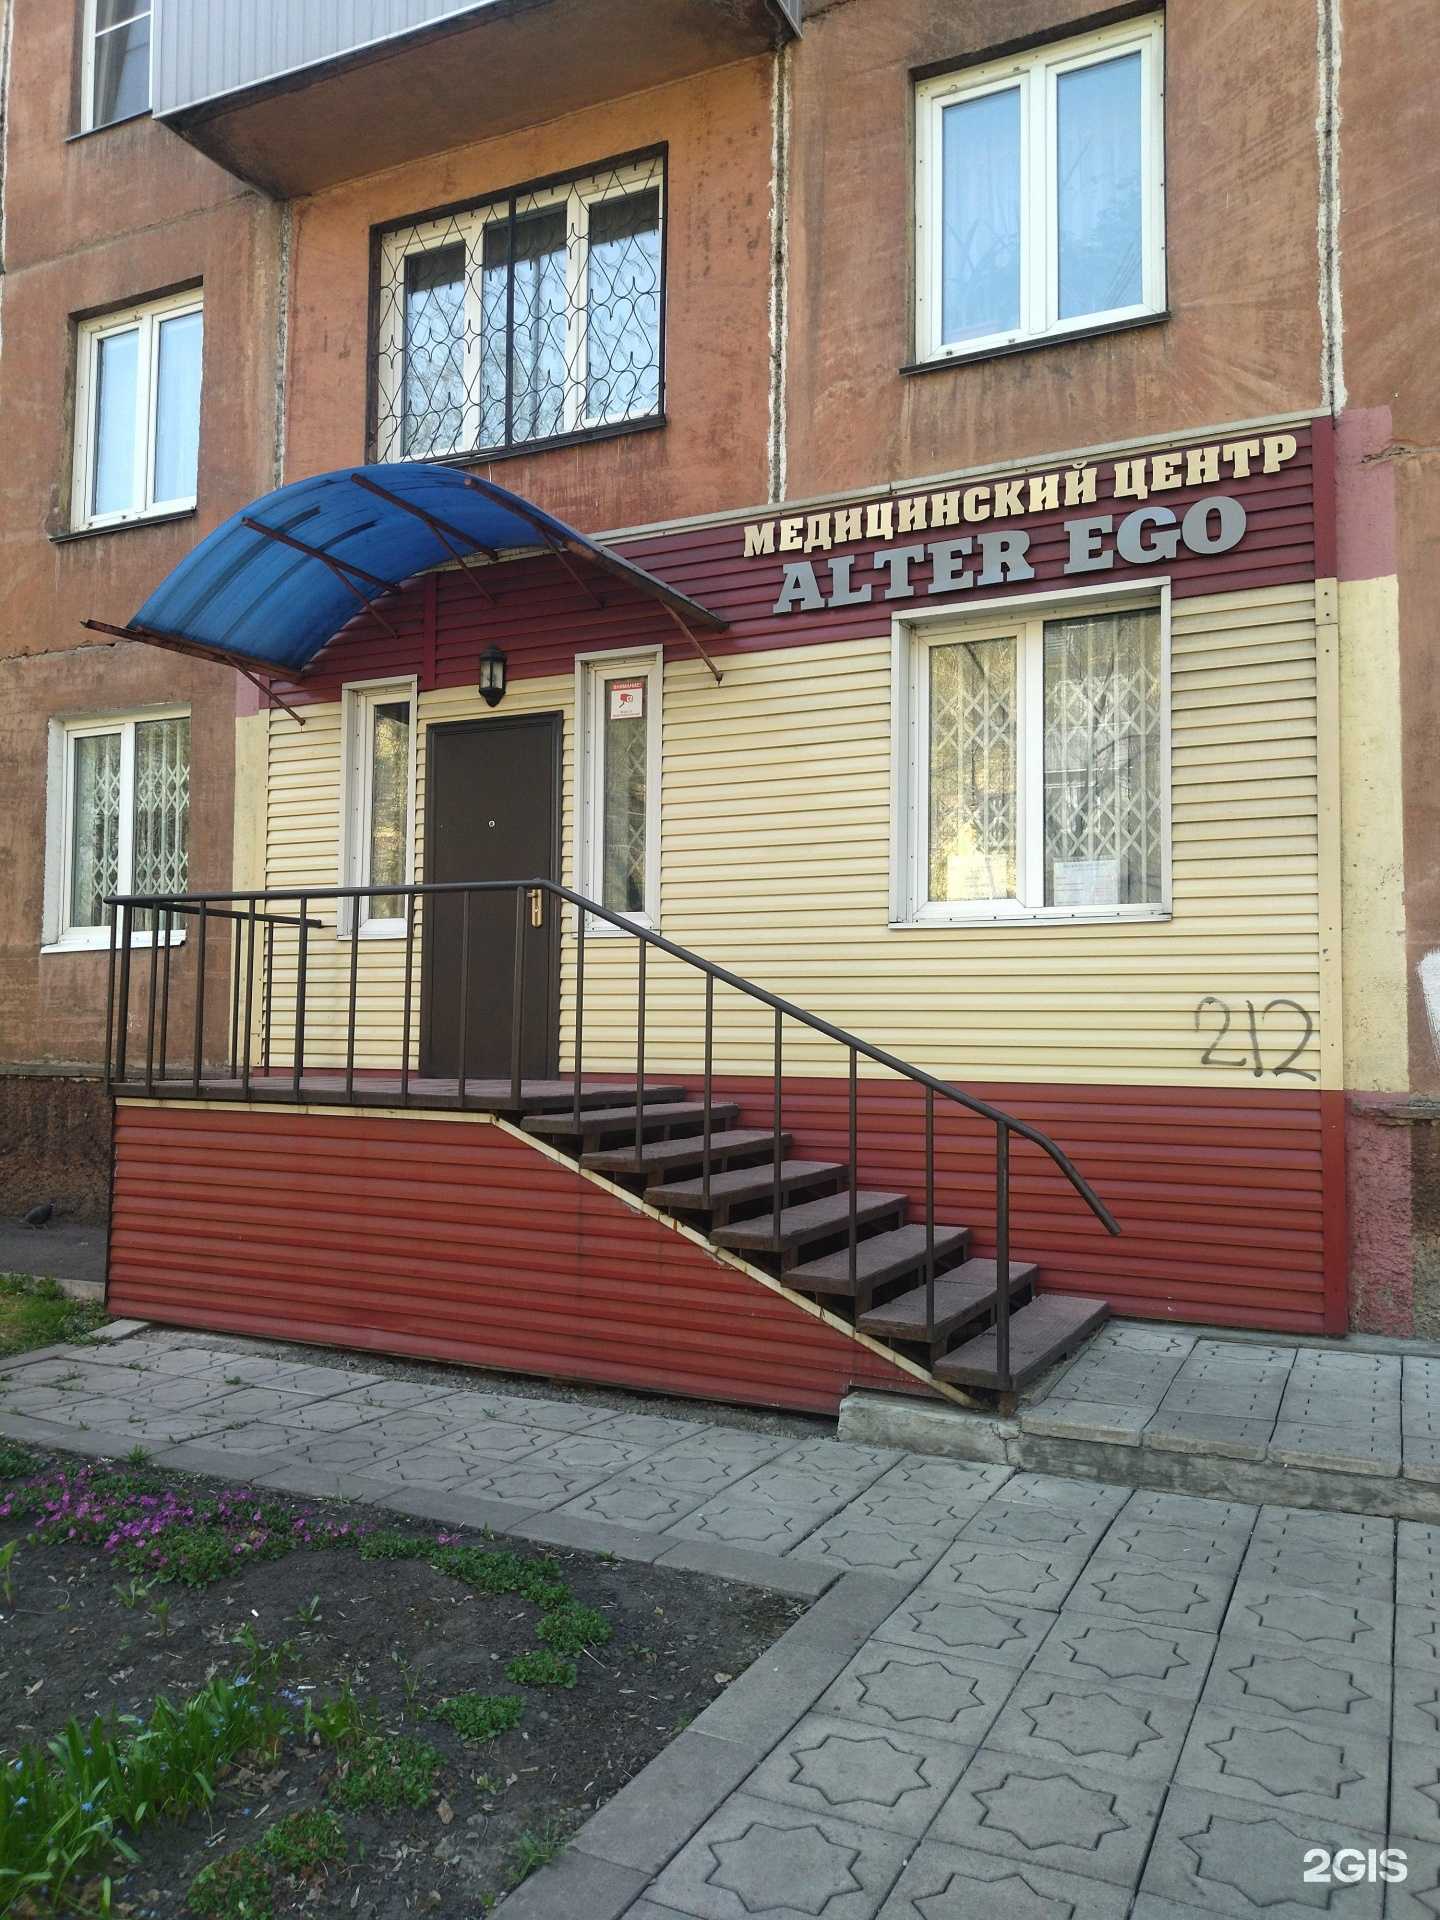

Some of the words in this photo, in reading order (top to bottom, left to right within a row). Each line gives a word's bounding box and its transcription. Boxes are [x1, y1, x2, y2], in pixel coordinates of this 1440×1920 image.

[743, 463, 1097, 557] МЕДИЦИНСКИЙ
[1113, 435, 1297, 500] ЦЕНТР
[772, 530, 1035, 614] ALTER
[1064, 495, 1247, 574] EGO
[1195, 997, 1316, 1082] 212
